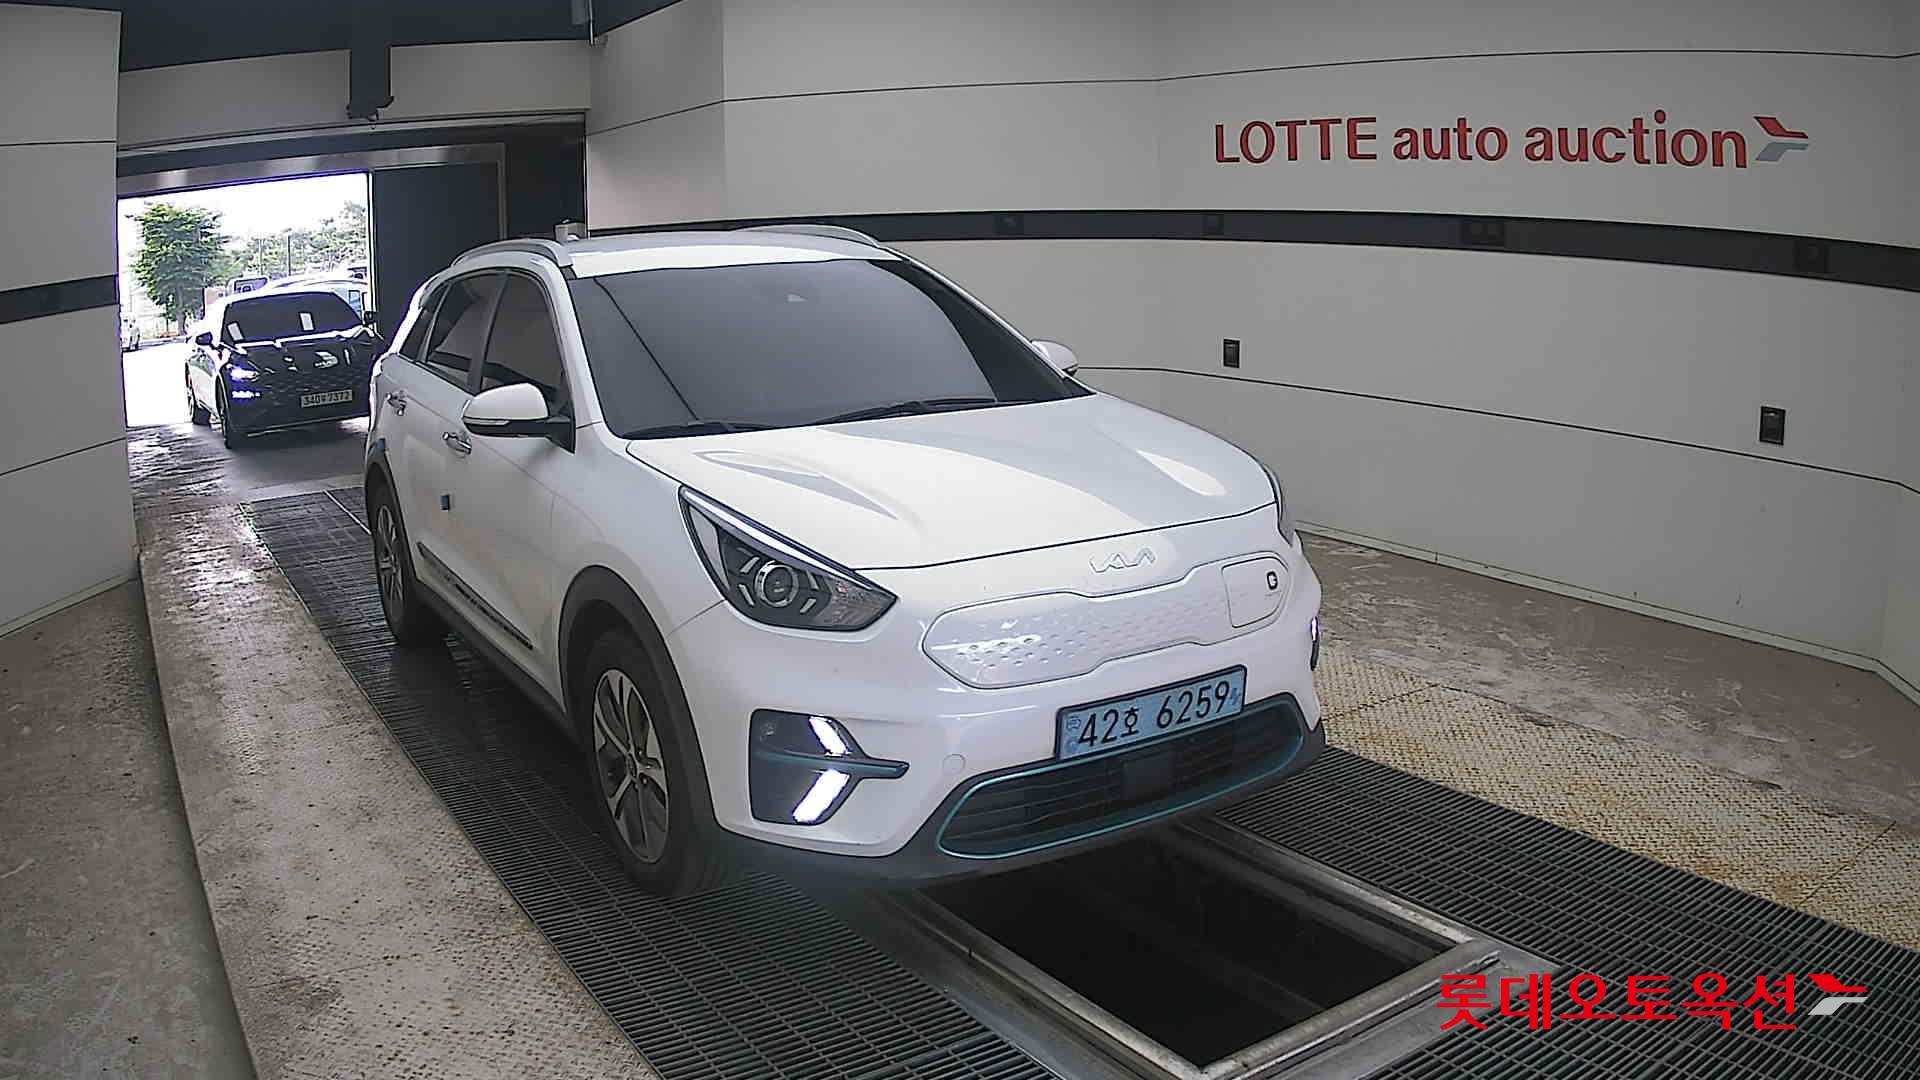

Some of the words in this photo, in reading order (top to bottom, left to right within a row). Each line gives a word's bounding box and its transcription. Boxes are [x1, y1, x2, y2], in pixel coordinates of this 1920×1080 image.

[1215, 117, 1377, 163] LOTTE
[1393, 117, 1508, 161] auto
[1524, 109, 1747, 168] auction
[1078, 707, 1140, 747] 42호
[1157, 681, 1230, 728] 6259
